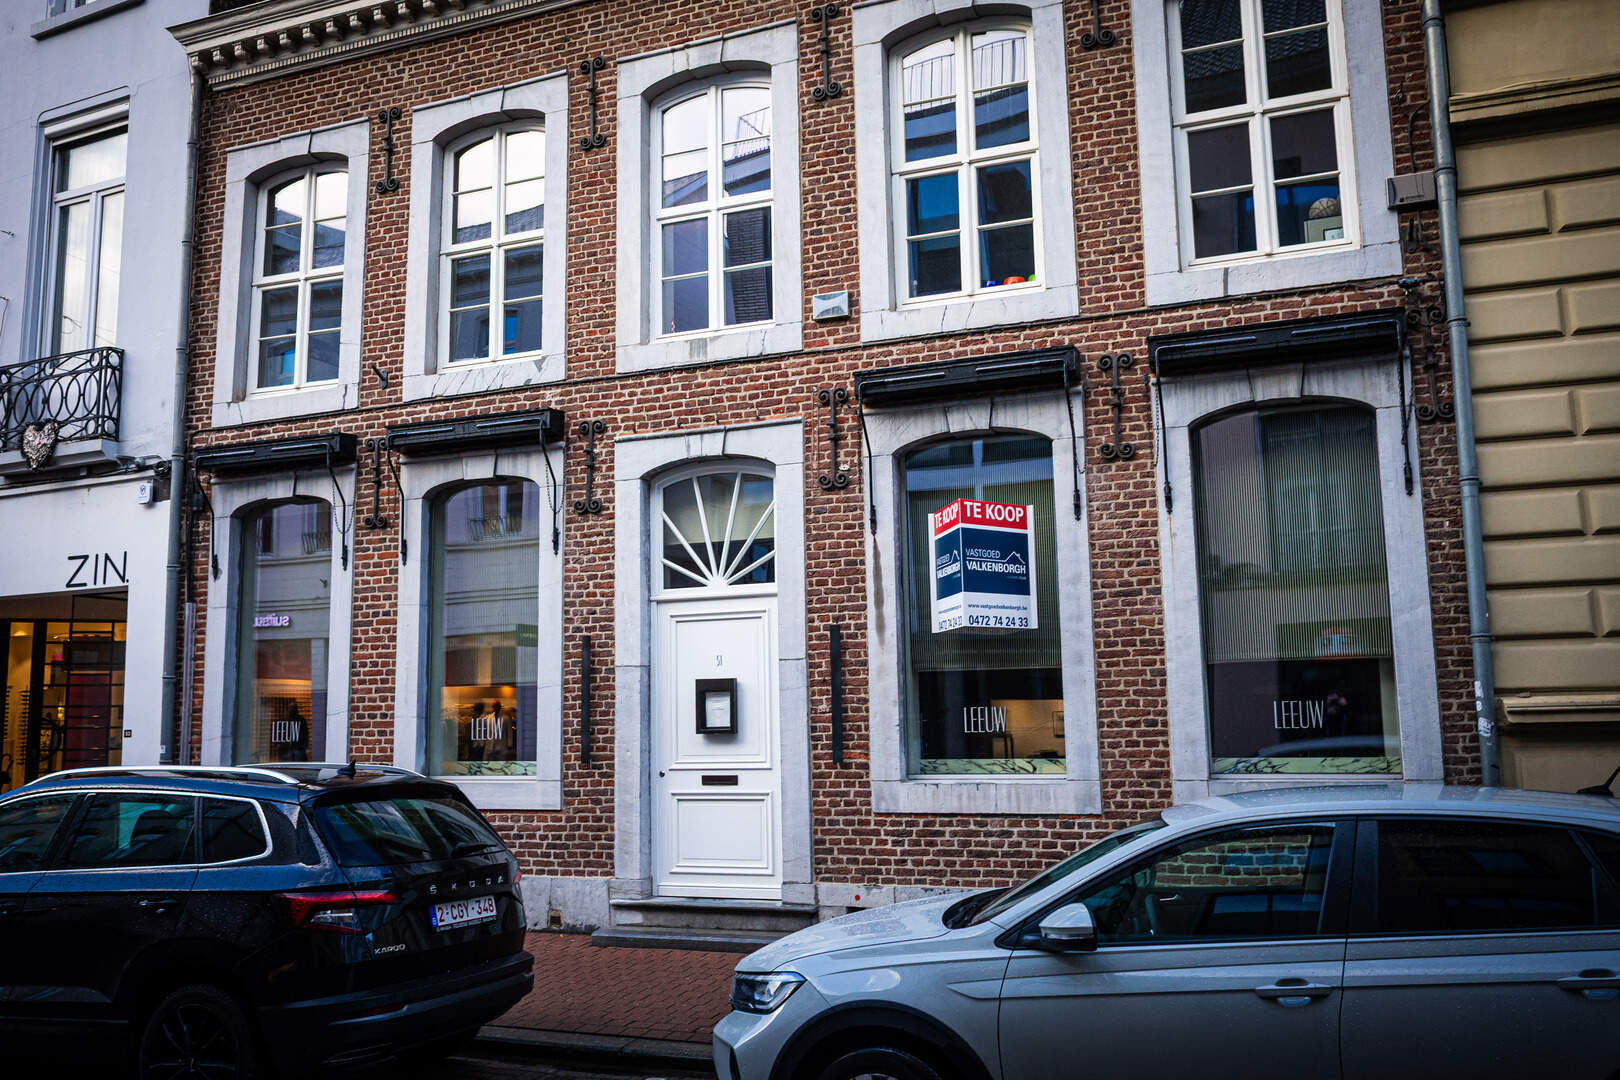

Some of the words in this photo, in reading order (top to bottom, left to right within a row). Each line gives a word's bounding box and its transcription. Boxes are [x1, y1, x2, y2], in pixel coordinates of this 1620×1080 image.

[934, 510, 943, 528] TE
[942, 503, 959, 524] KOOP
[963, 501, 982, 519] TE
[985, 503, 1024, 522] KOOP
[965, 548, 1000, 559] VASTGOED
[966, 561, 1027, 574] VALKENBORGH
[968, 614, 990, 626] 0472
[993, 616, 1003, 627] 74
[1005, 616, 1016, 627] 24
[1018, 617, 1029, 627] 33
[963, 706, 1007, 733] LEEUW
[1273, 700, 1324, 728] LEEUW
[272, 720, 301, 743] LEEUW
[471, 717, 504, 741] LEEUW
